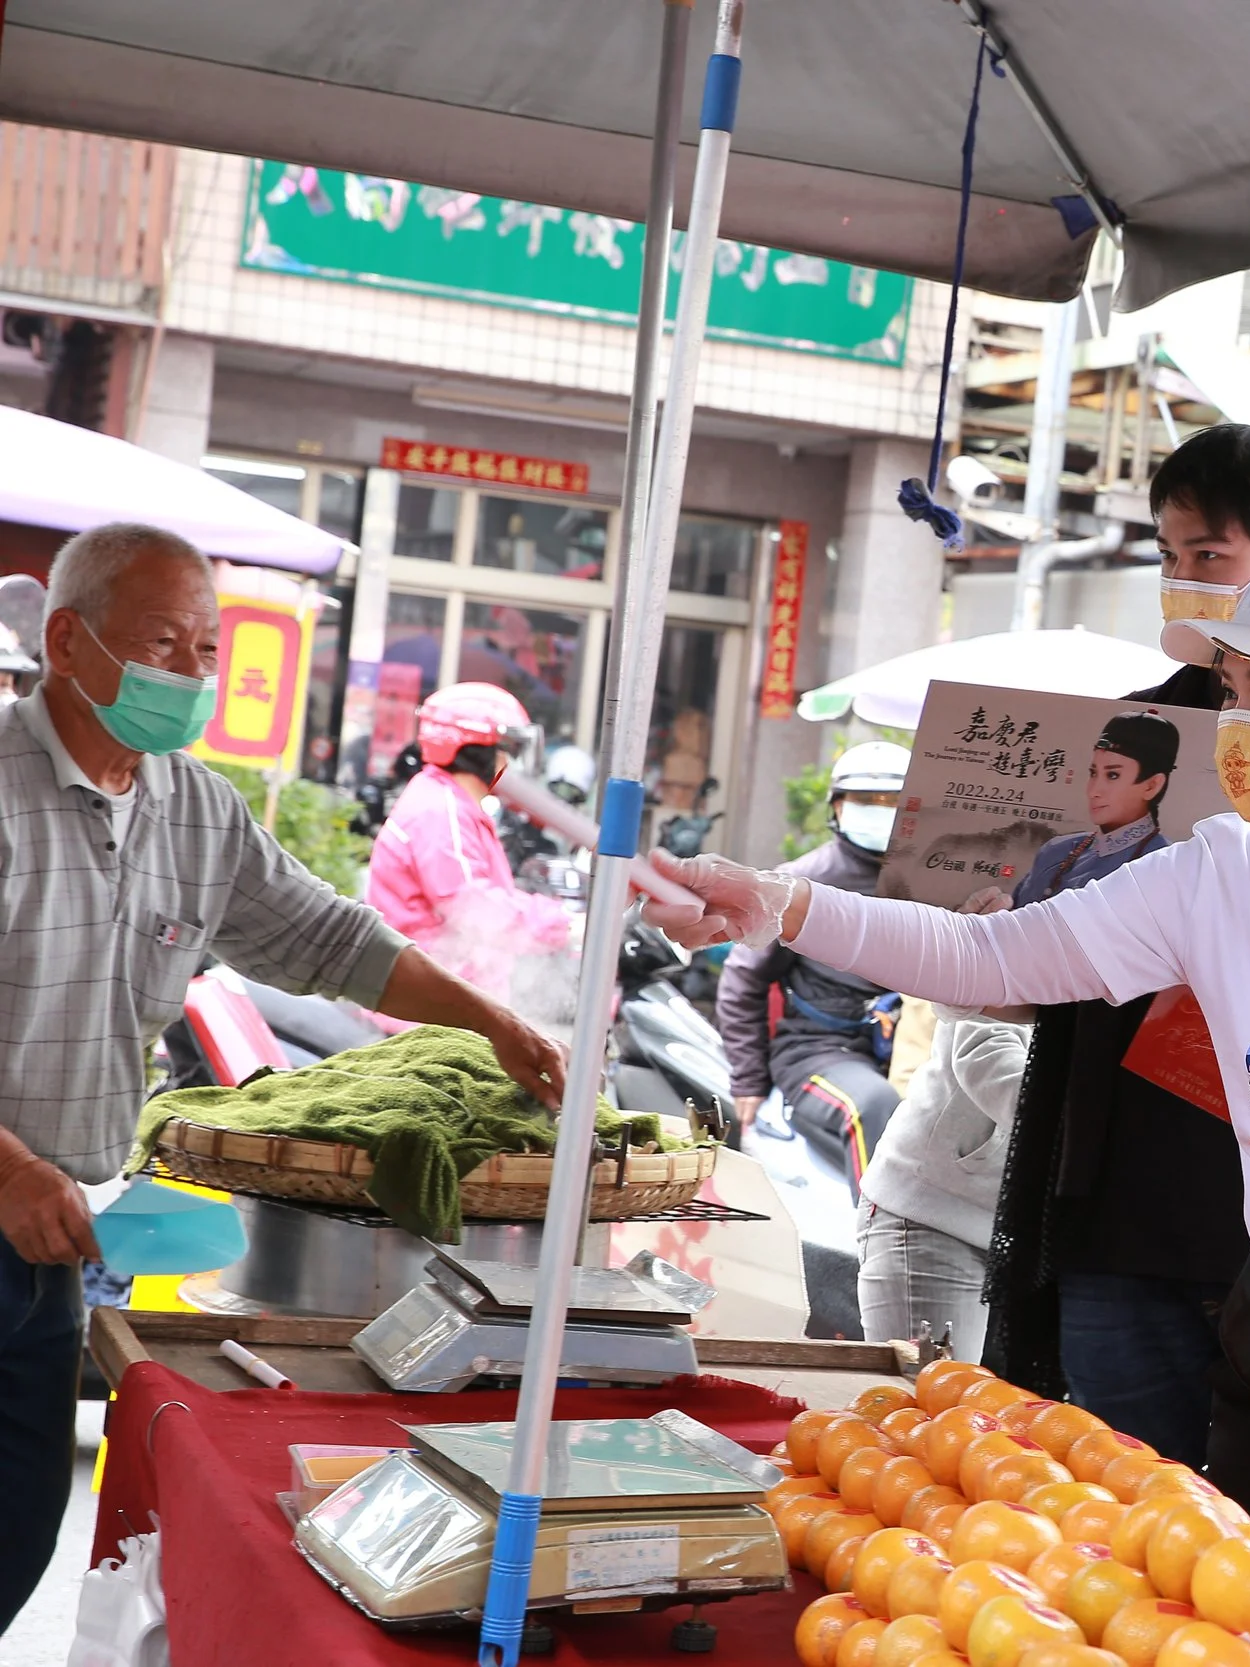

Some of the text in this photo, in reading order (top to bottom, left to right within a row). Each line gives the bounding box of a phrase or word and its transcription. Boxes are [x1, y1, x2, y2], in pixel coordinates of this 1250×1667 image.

[234, 668, 272, 703] 元
[954, 706, 1040, 748] 嘉慶君
[986, 747, 1066, 783] 遊臺灣
[945, 781, 1026, 803] 2022.2.24
[942, 859, 966, 873] 台視
